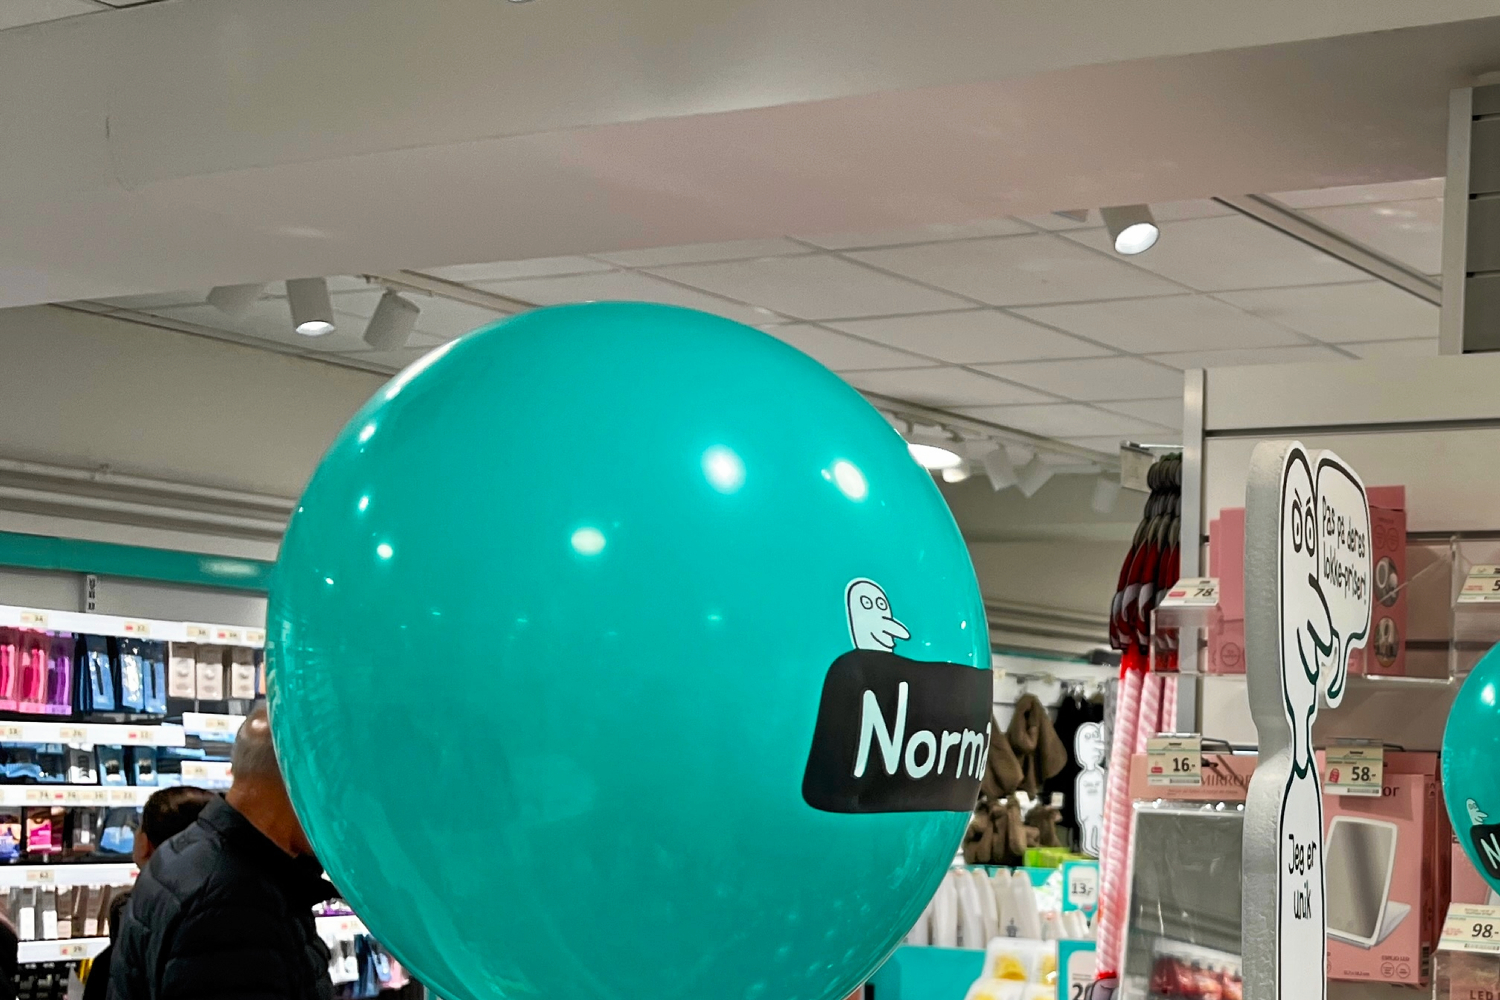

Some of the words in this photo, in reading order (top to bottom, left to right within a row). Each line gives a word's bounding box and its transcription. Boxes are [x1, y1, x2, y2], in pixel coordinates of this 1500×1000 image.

[1322, 495, 1336, 538] Pas
[853, 681, 990, 782] Norm
[1288, 833, 1305, 876] Jeg
[1306, 840, 1317, 869] er
[1293, 880, 1312, 920] unik
[1469, 990, 1494, 1000] LED
